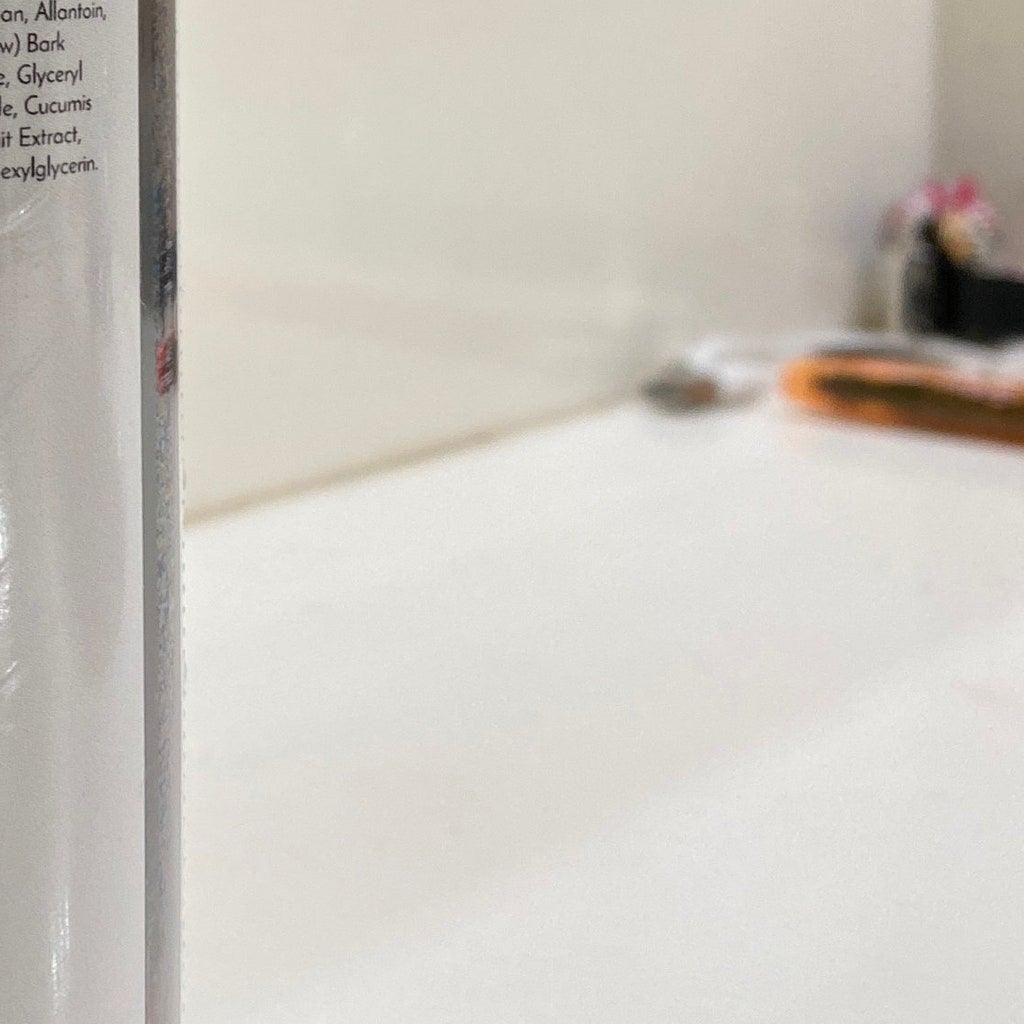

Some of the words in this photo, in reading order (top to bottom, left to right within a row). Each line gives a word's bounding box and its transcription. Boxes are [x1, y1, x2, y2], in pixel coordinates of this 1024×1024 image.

[35, 0, 107, 21] Allantoin,
[27, 31, 65, 53] Bark
[17, 60, 82, 87] Glyceryl
[24, 94, 92, 115] Cucumis
[19, 126, 81, 148] Extract,
